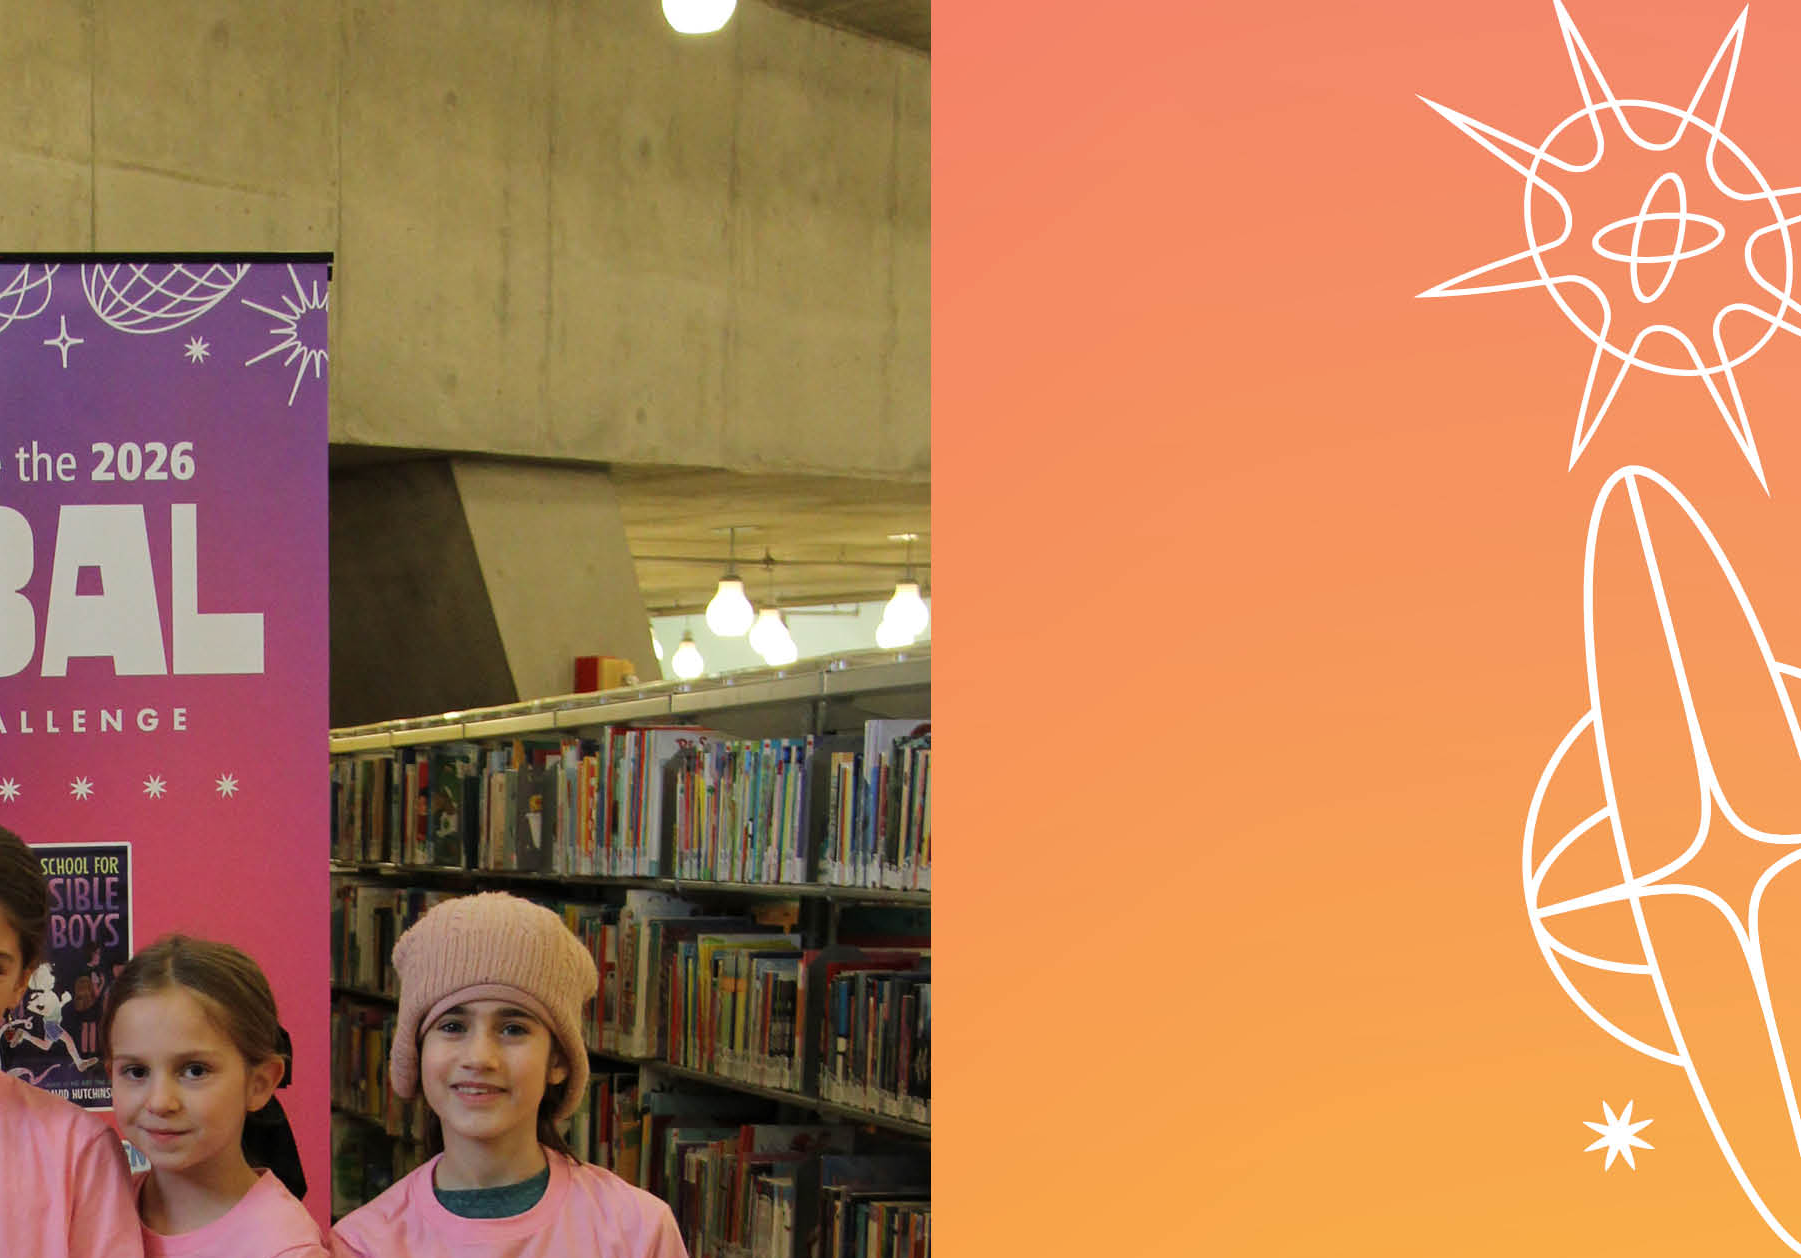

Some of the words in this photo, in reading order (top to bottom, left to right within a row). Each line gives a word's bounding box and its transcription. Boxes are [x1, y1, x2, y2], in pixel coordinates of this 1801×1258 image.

[16, 441, 77, 482] the
[90, 441, 196, 482] 2026
[40, 856, 89, 875] SCHOOL
[94, 856, 119, 874] FOR
[51, 913, 120, 949] BOYS
